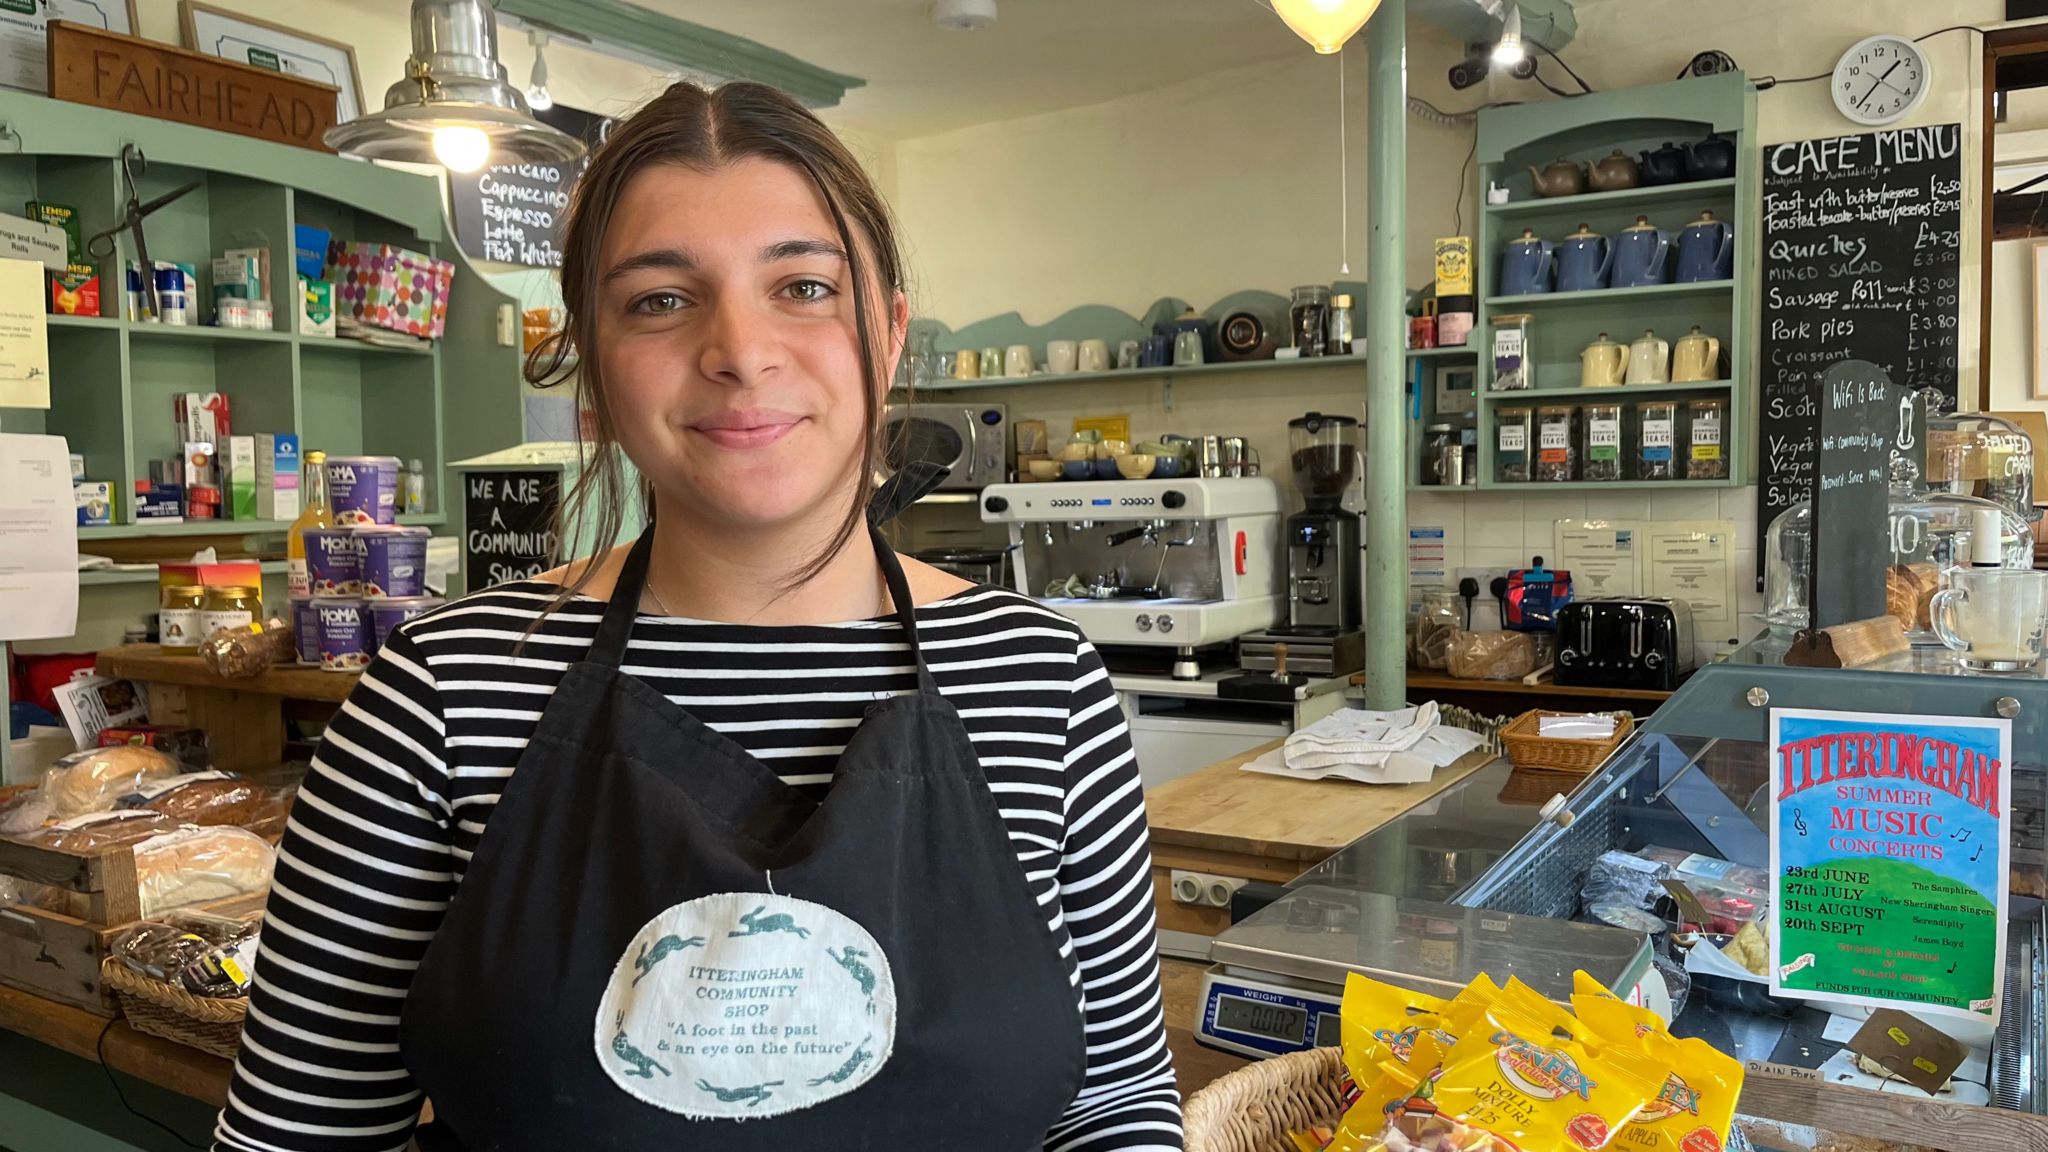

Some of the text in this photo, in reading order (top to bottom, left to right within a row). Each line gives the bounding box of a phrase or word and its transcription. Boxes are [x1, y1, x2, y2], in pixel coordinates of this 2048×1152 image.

[1860, 54, 1868, 64] 11
[1874, 47, 1884, 57] 12
[1894, 49, 1898, 58] 1
[1849, 66, 1860, 76] 10
[1904, 57, 1911, 67] 2
[1910, 71, 1916, 80] 3
[93, 50, 316, 140] FAIRHEAD
[1844, 82, 1851, 91] 9
[1903, 88, 1911, 96] 4
[1850, 95, 1857, 105] 8
[1864, 103, 1871, 113] 7
[1878, 104, 1885, 113] 6
[1894, 98, 1900, 107] 5
[1874, 125, 1959, 166] MENU
[478, 173, 569, 209] Cappuccino
[1763, 190, 1805, 213] Toast
[1809, 188, 1843, 209] with
[41, 204, 72, 218] LEMSIP
[481, 197, 552, 229] Espresso
[484, 219, 525, 243] Latte
[1763, 210, 1816, 234] Toasted
[11, 242, 29, 254] Rolls
[18, 234, 30, 243] and
[32, 236, 60, 252] Sausage
[1769, 234, 1867, 266] Quiches
[1769, 266, 1819, 281] MIXED
[1828, 261, 1883, 277] SALAD
[1769, 287, 1839, 309] Sausage
[1851, 279, 1885, 302] Roll
[1772, 318, 1810, 341] Pork
[1821, 318, 1854, 344] pies
[1772, 348, 1852, 366] Croissant
[1778, 368, 1808, 383] Pain
[1848, 469, 1864, 484] Since
[471, 478, 540, 505] WE ARE
[491, 506, 507, 531] A
[469, 529, 559, 562] COMMUNITY
[1777, 731, 2001, 819] ITTERINGHAM
[1837, 785, 1932, 806] SUMMER
[1829, 806, 1944, 839] MUSIC
[1829, 836, 1944, 860] CONCERTS
[1785, 865, 1870, 885] 23rd JUNE
[1785, 882, 1865, 901] 27th JULY
[1912, 881, 1978, 896] The Samphires
[1784, 899, 1885, 921] 31st AUGUST
[1880, 896, 1996, 917] New Sheringham Singers
[1785, 917, 1865, 936] 20th SEPT
[1912, 915, 1965, 930] Serendipity
[1913, 934, 1965, 949] James Boyd
[688, 965, 804, 983] ITTERINGHAM
[1783, 955, 1812, 975] RAISING
[696, 985, 798, 1001] COMMUNITY
[1243, 989, 1284, 1003] WEIGHT
[1815, 980, 1960, 1006] FUNDS FOR OUR COMMUNITY
[724, 1004, 769, 1018] SHOP
[1974, 998, 1994, 1010] SHOP
[691, 1022, 726, 1037] foot
[731, 1023, 745, 1036] in
[751, 1022, 779, 1036] the
[784, 1023, 818, 1040] past
[657, 1039, 670, 1052] &
[675, 1042, 695, 1054] an
[701, 1043, 727, 1058] eye
[734, 1042, 754, 1055] on
[761, 1040, 787, 1055] the
[1488, 1030, 1598, 1102] CONFEX
[1496, 1046, 1564, 1101] Confectionery
[1472, 1086, 1534, 1128] MIXTURE
[1488, 1081, 1539, 1115] DOLLY
[1627, 1126, 1661, 1147] APPLES
